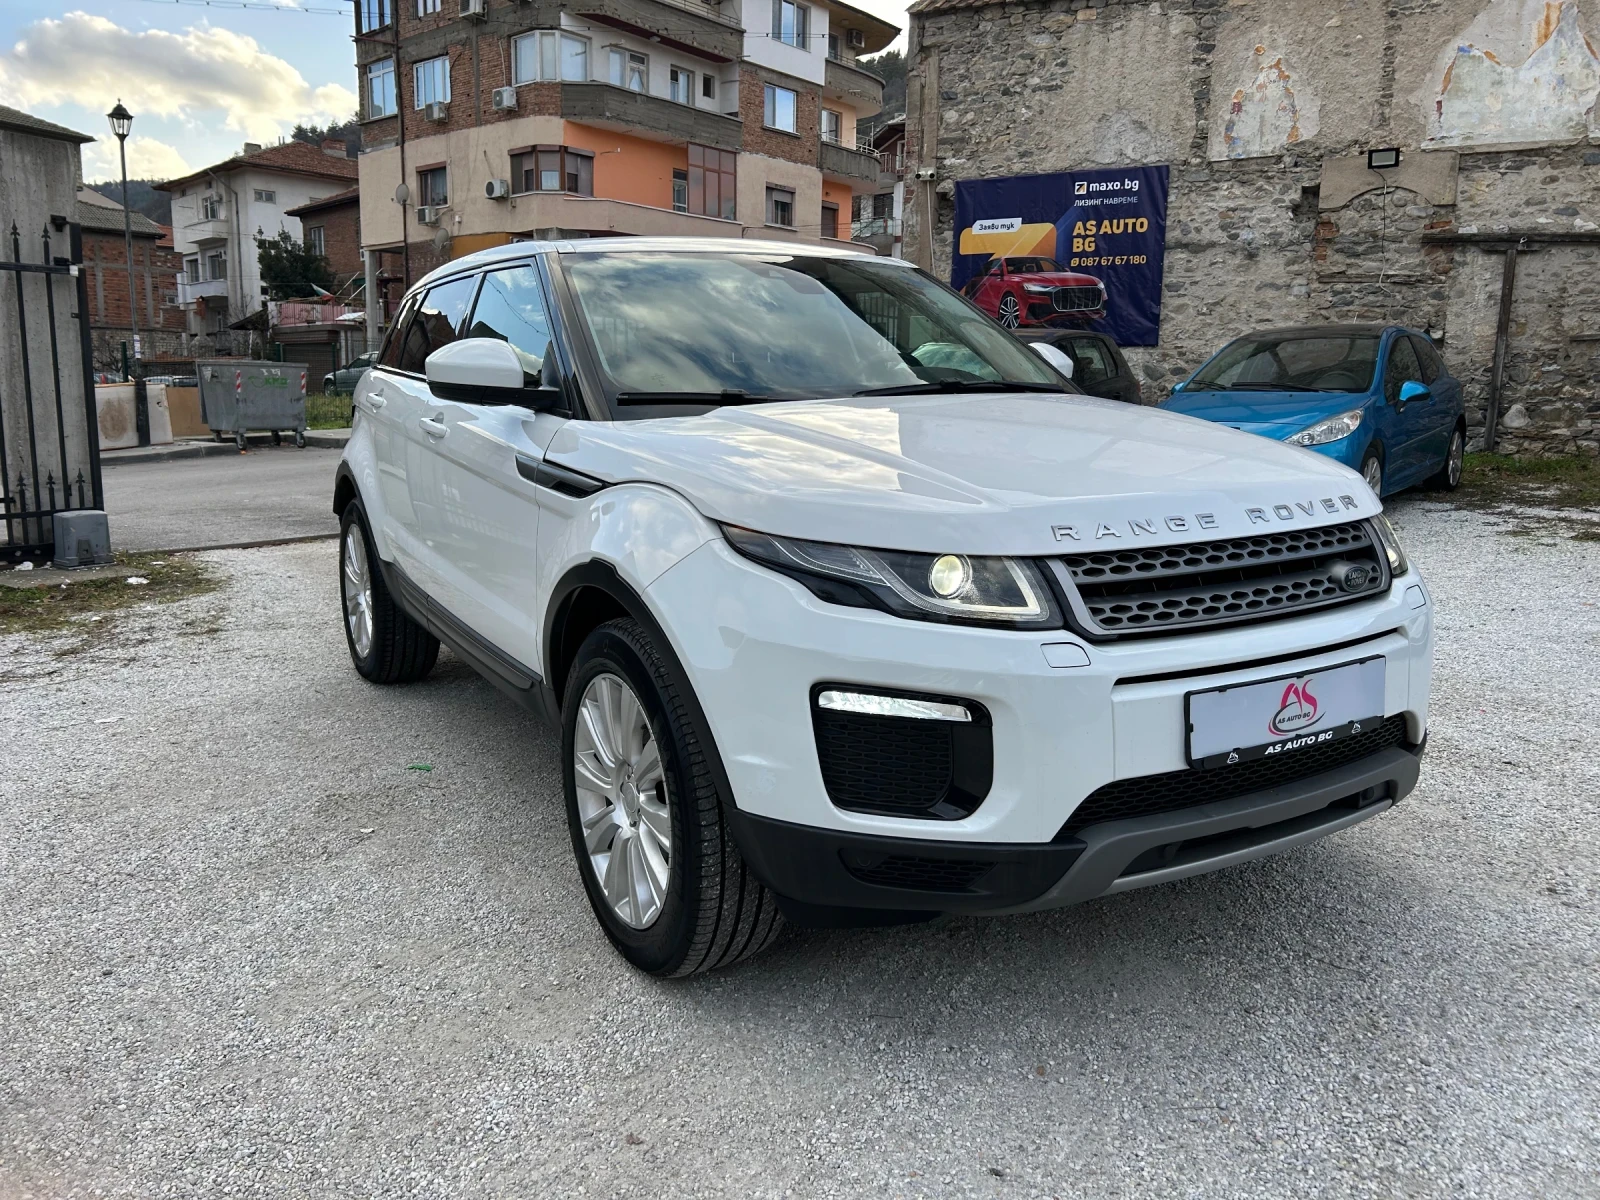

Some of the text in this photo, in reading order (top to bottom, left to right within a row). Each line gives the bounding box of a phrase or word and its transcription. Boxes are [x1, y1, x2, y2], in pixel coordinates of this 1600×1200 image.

[1089, 178, 1139, 191] maxo.bg
[1074, 196, 1139, 207] ЛИЗИНГ НАВРЕМЕ
[1072, 217, 1149, 236] AS AUTO
[1072, 237, 1096, 252] BG
[1080, 255, 1147, 266] 087 67 67 180
[1050, 494, 1359, 542] RANGE ROVER
[1281, 678, 1318, 722] AS
[1302, 711, 1311, 719] BG
[1264, 731, 1333, 755] AS AUTO BG
